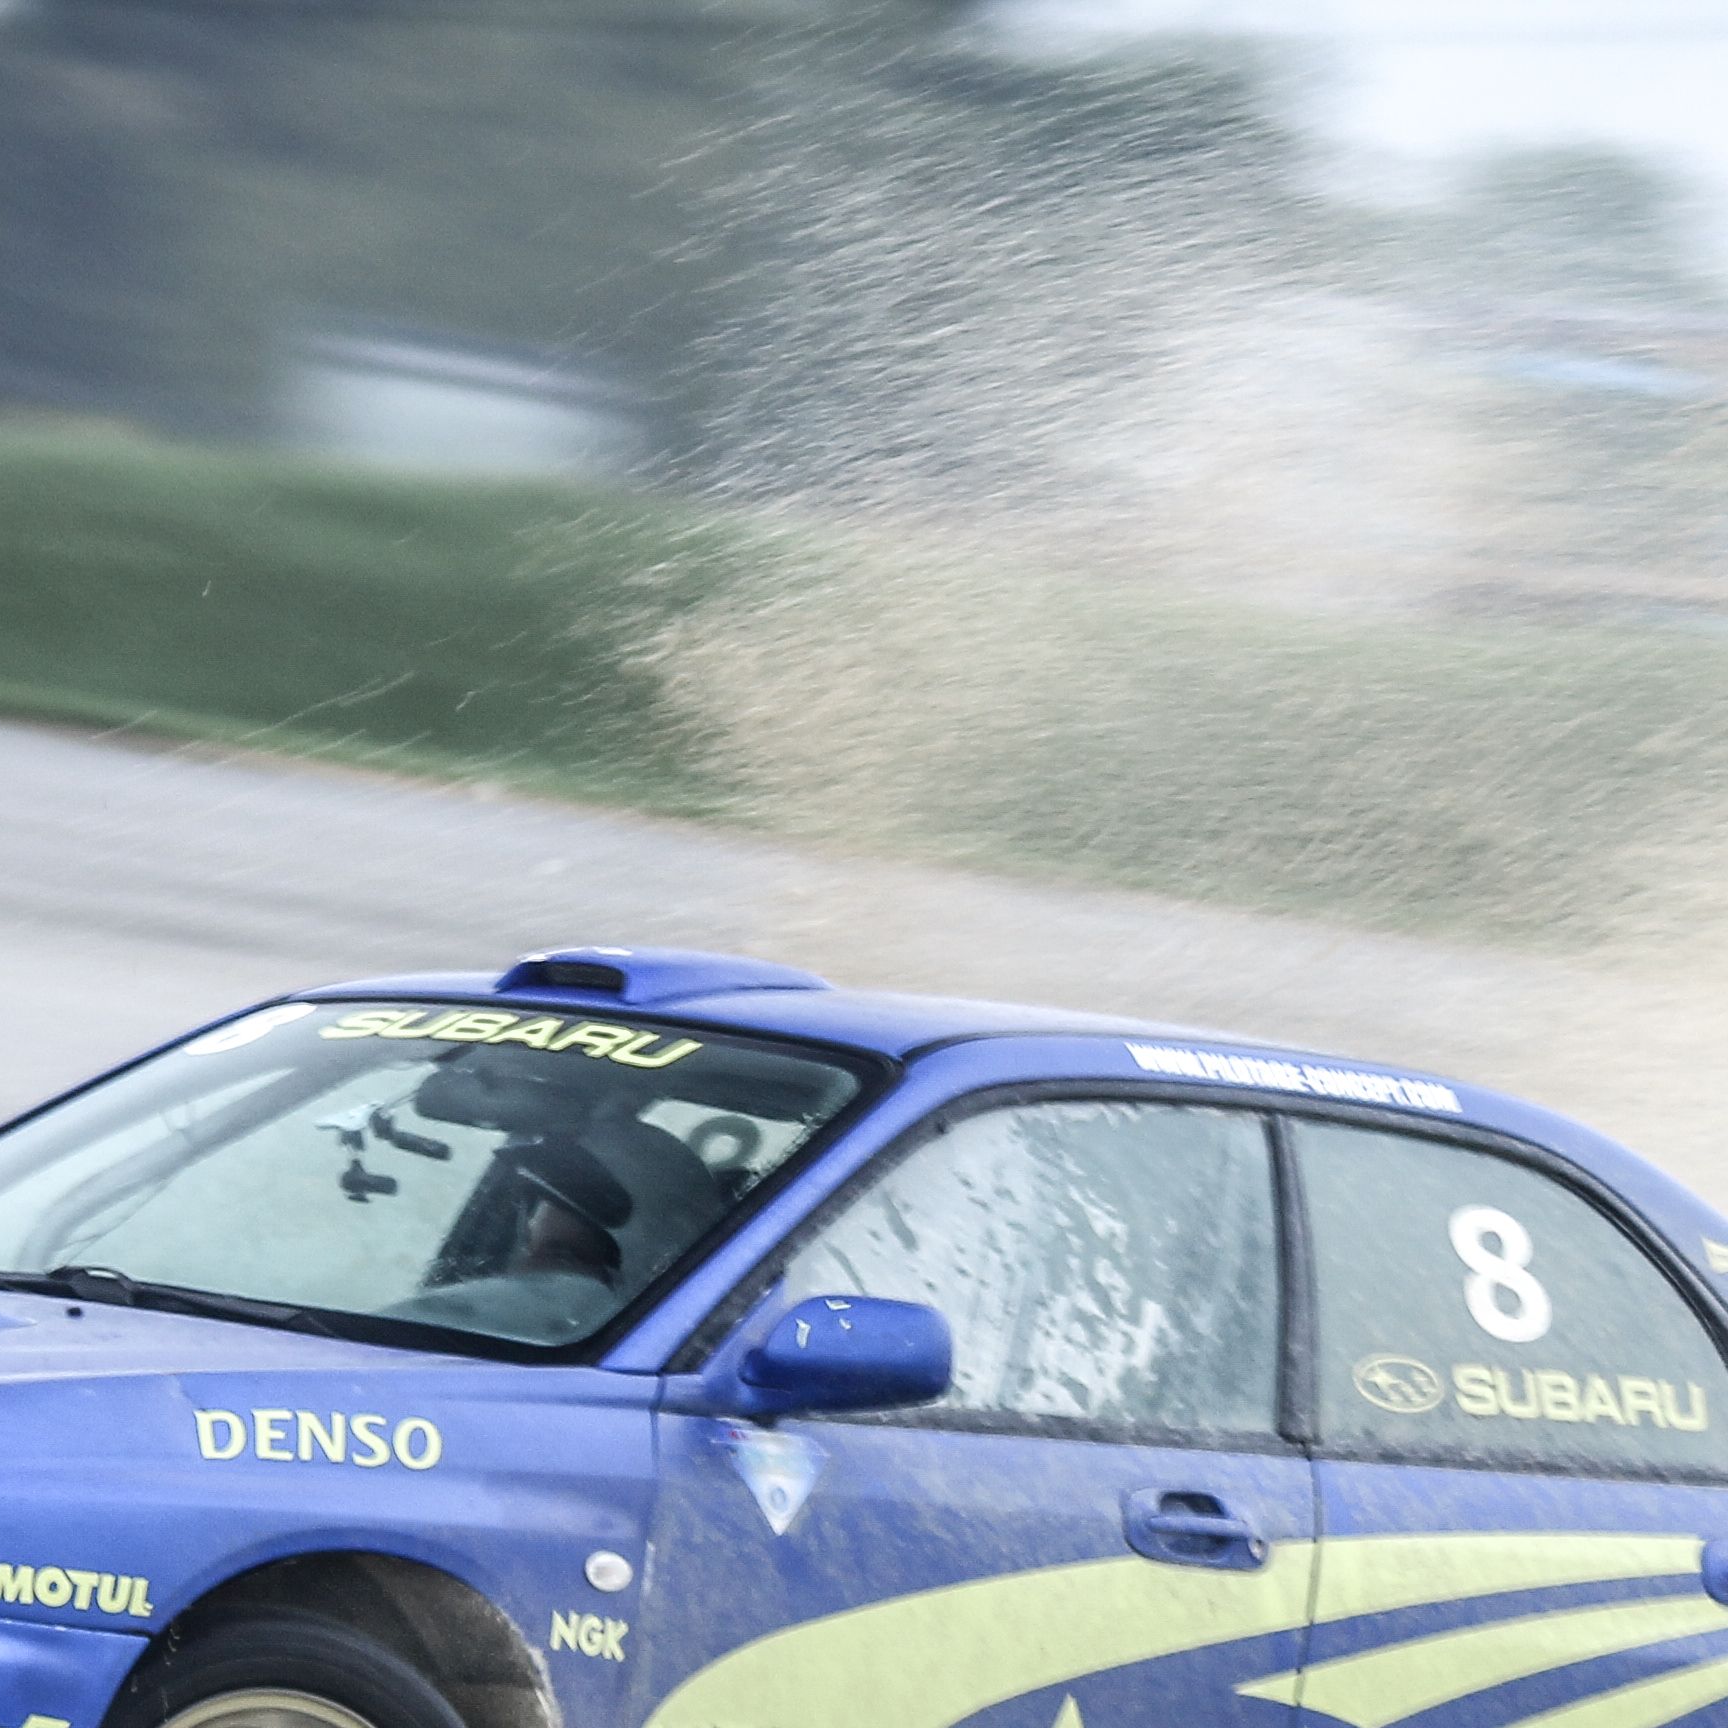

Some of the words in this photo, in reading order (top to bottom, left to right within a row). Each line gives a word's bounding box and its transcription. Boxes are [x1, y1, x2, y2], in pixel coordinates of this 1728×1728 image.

[319, 1008, 703, 1069] SUBARU
[1448, 1203, 1553, 1343] 8
[1451, 1361, 1708, 1432] SUBARU
[194, 1408, 443, 1471] DENSO
[549, 1609, 629, 1663] NGK
